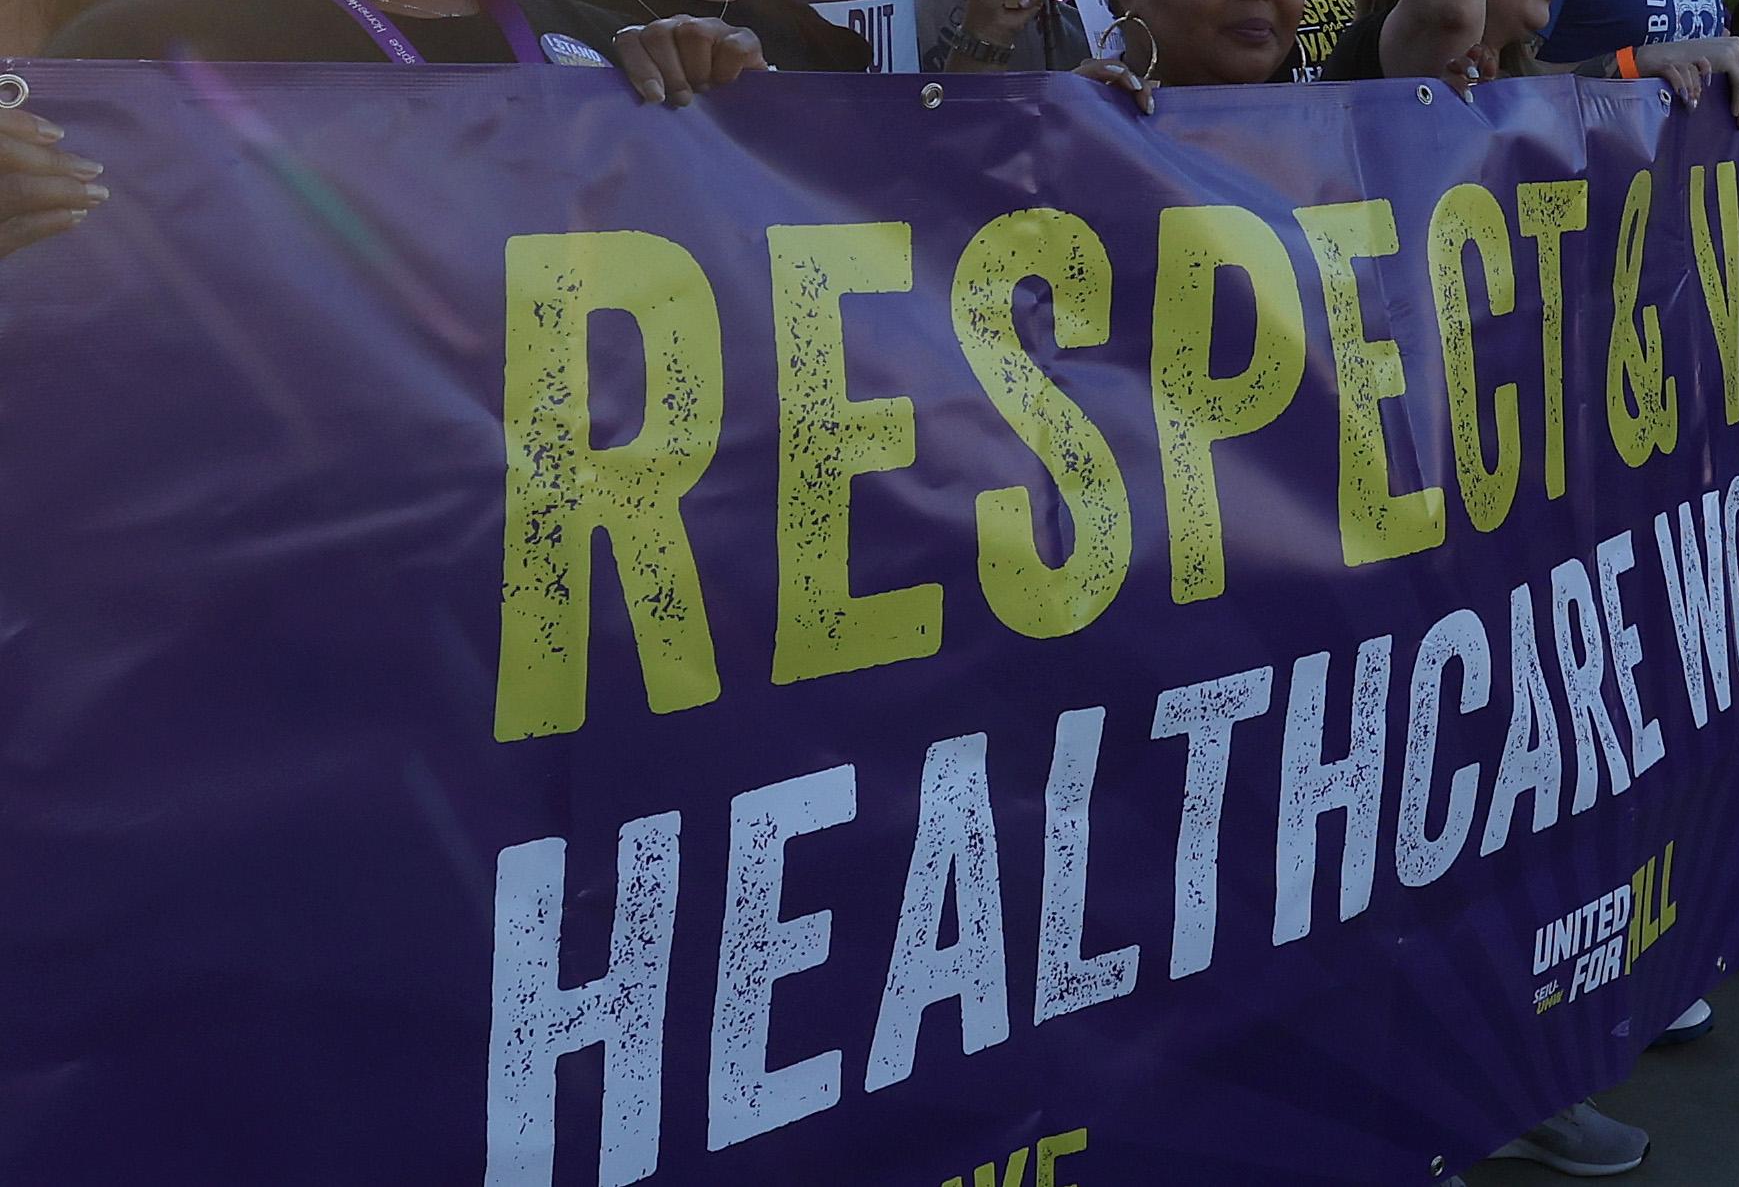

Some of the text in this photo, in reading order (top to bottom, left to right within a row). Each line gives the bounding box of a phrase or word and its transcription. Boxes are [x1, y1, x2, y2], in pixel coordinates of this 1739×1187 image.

[493, 177, 1589, 743] RESPECT
[1604, 168, 1678, 471] &
[485, 528, 1668, 1187] HEALTHCARE
[1533, 884, 1631, 975] UNITED
[1568, 840, 1677, 1003] FOR ALL
